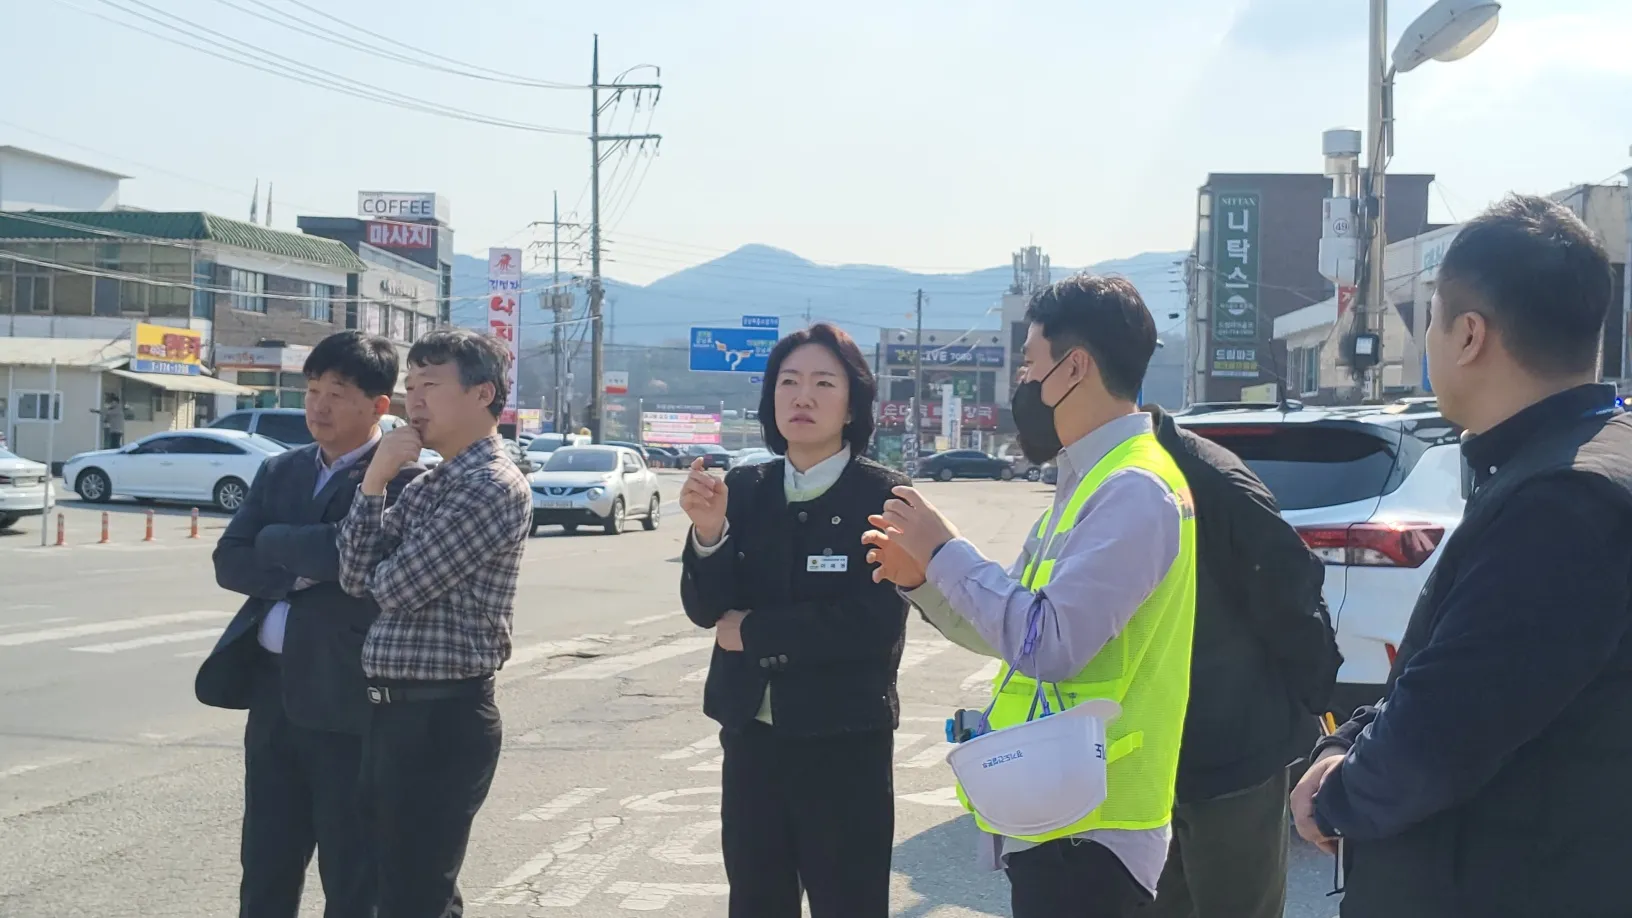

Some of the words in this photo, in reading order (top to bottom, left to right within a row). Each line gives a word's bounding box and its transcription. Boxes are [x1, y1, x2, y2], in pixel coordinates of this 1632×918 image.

[363, 199, 431, 215] COFFEE
[1221, 197, 1257, 206] NITTAX
[370, 223, 428, 246] 마사지
[1225, 208, 1251, 289] 니탁스
